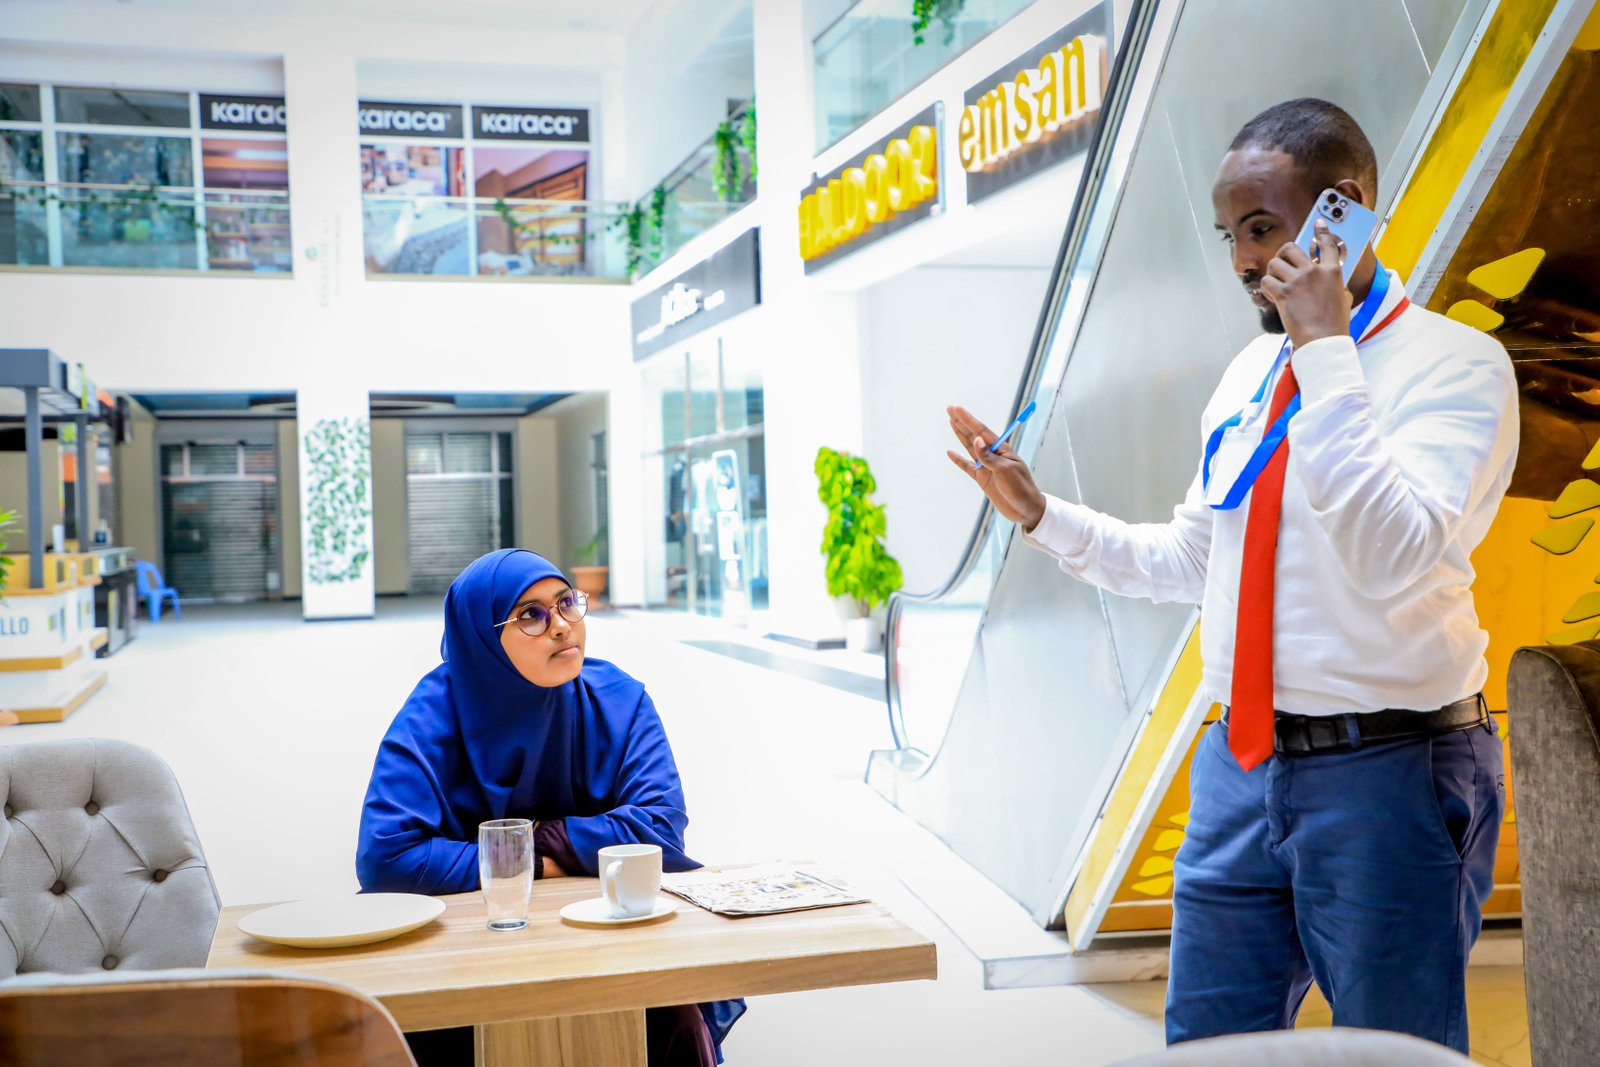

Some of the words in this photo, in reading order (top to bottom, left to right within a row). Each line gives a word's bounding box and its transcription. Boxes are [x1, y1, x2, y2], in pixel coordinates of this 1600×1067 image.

[211, 101, 287, 124] karac
[959, 33, 1100, 172] emsan
[481, 112, 573, 136] karaca
